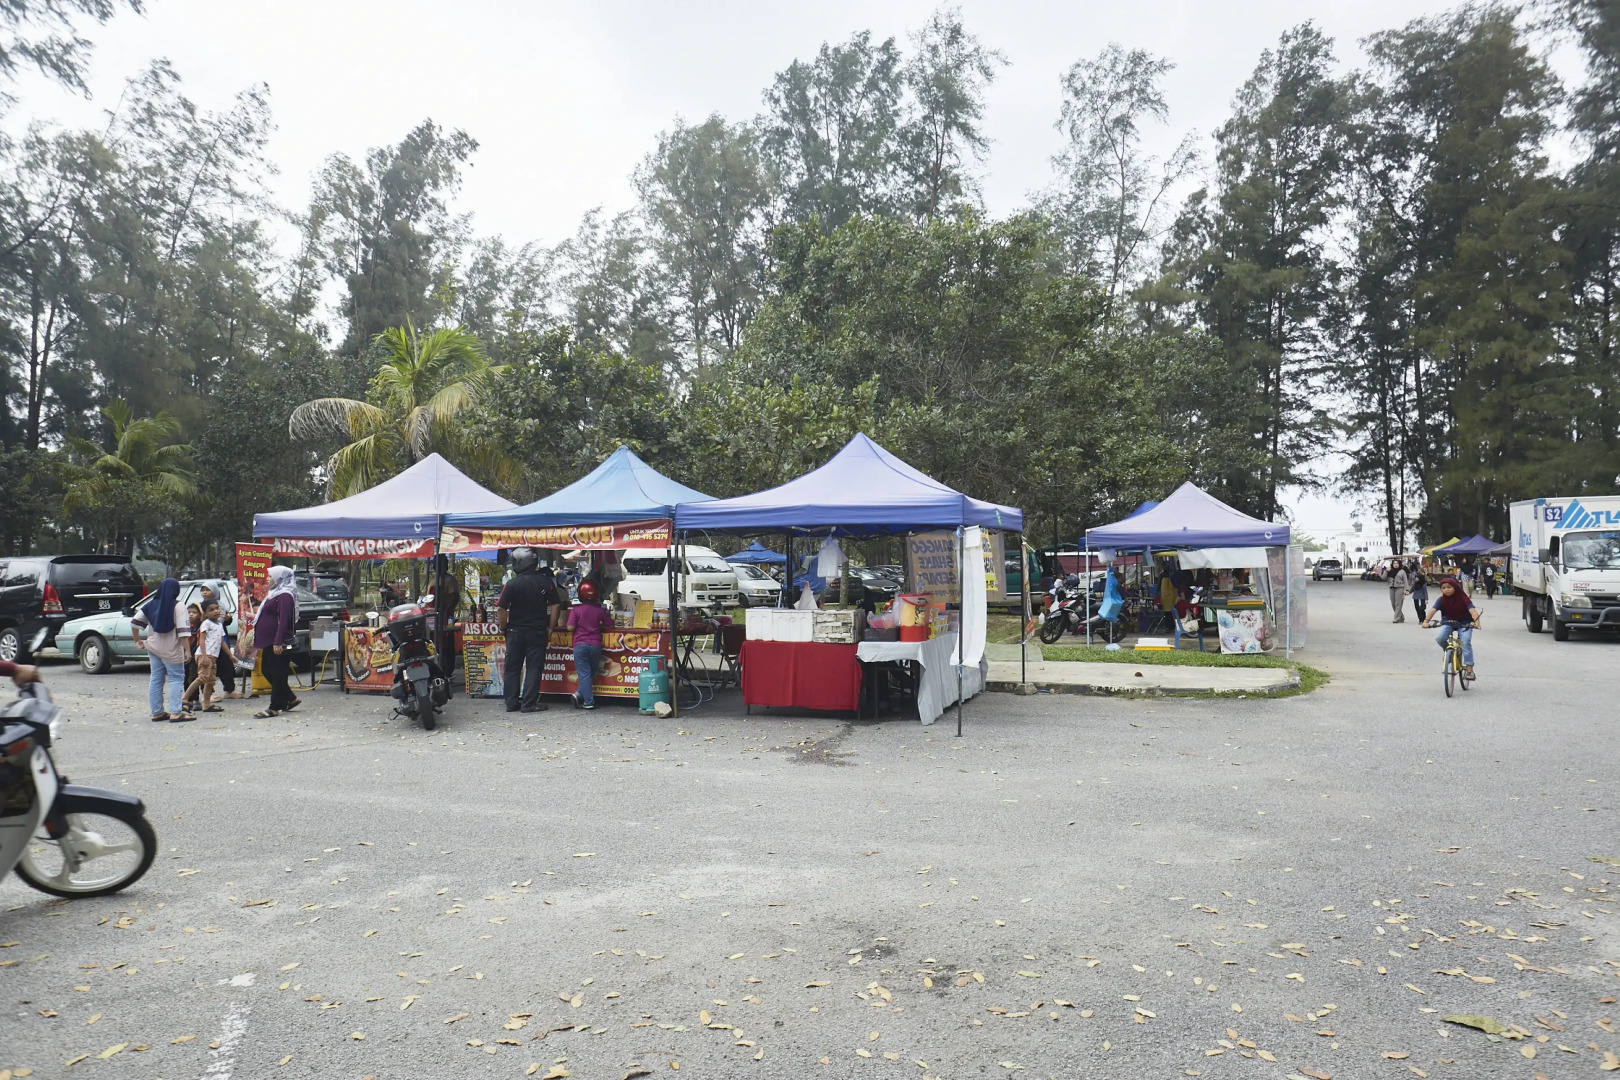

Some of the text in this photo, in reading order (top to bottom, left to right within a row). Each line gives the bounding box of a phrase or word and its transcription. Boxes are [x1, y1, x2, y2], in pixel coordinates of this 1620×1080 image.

[1546, 508, 1560, 520] S2
[481, 526, 613, 547] APAM BALIK QUE
[305, 539, 365, 556] GUNTING
[464, 623, 502, 635] AIS KO
[623, 633, 660, 652] QUE
